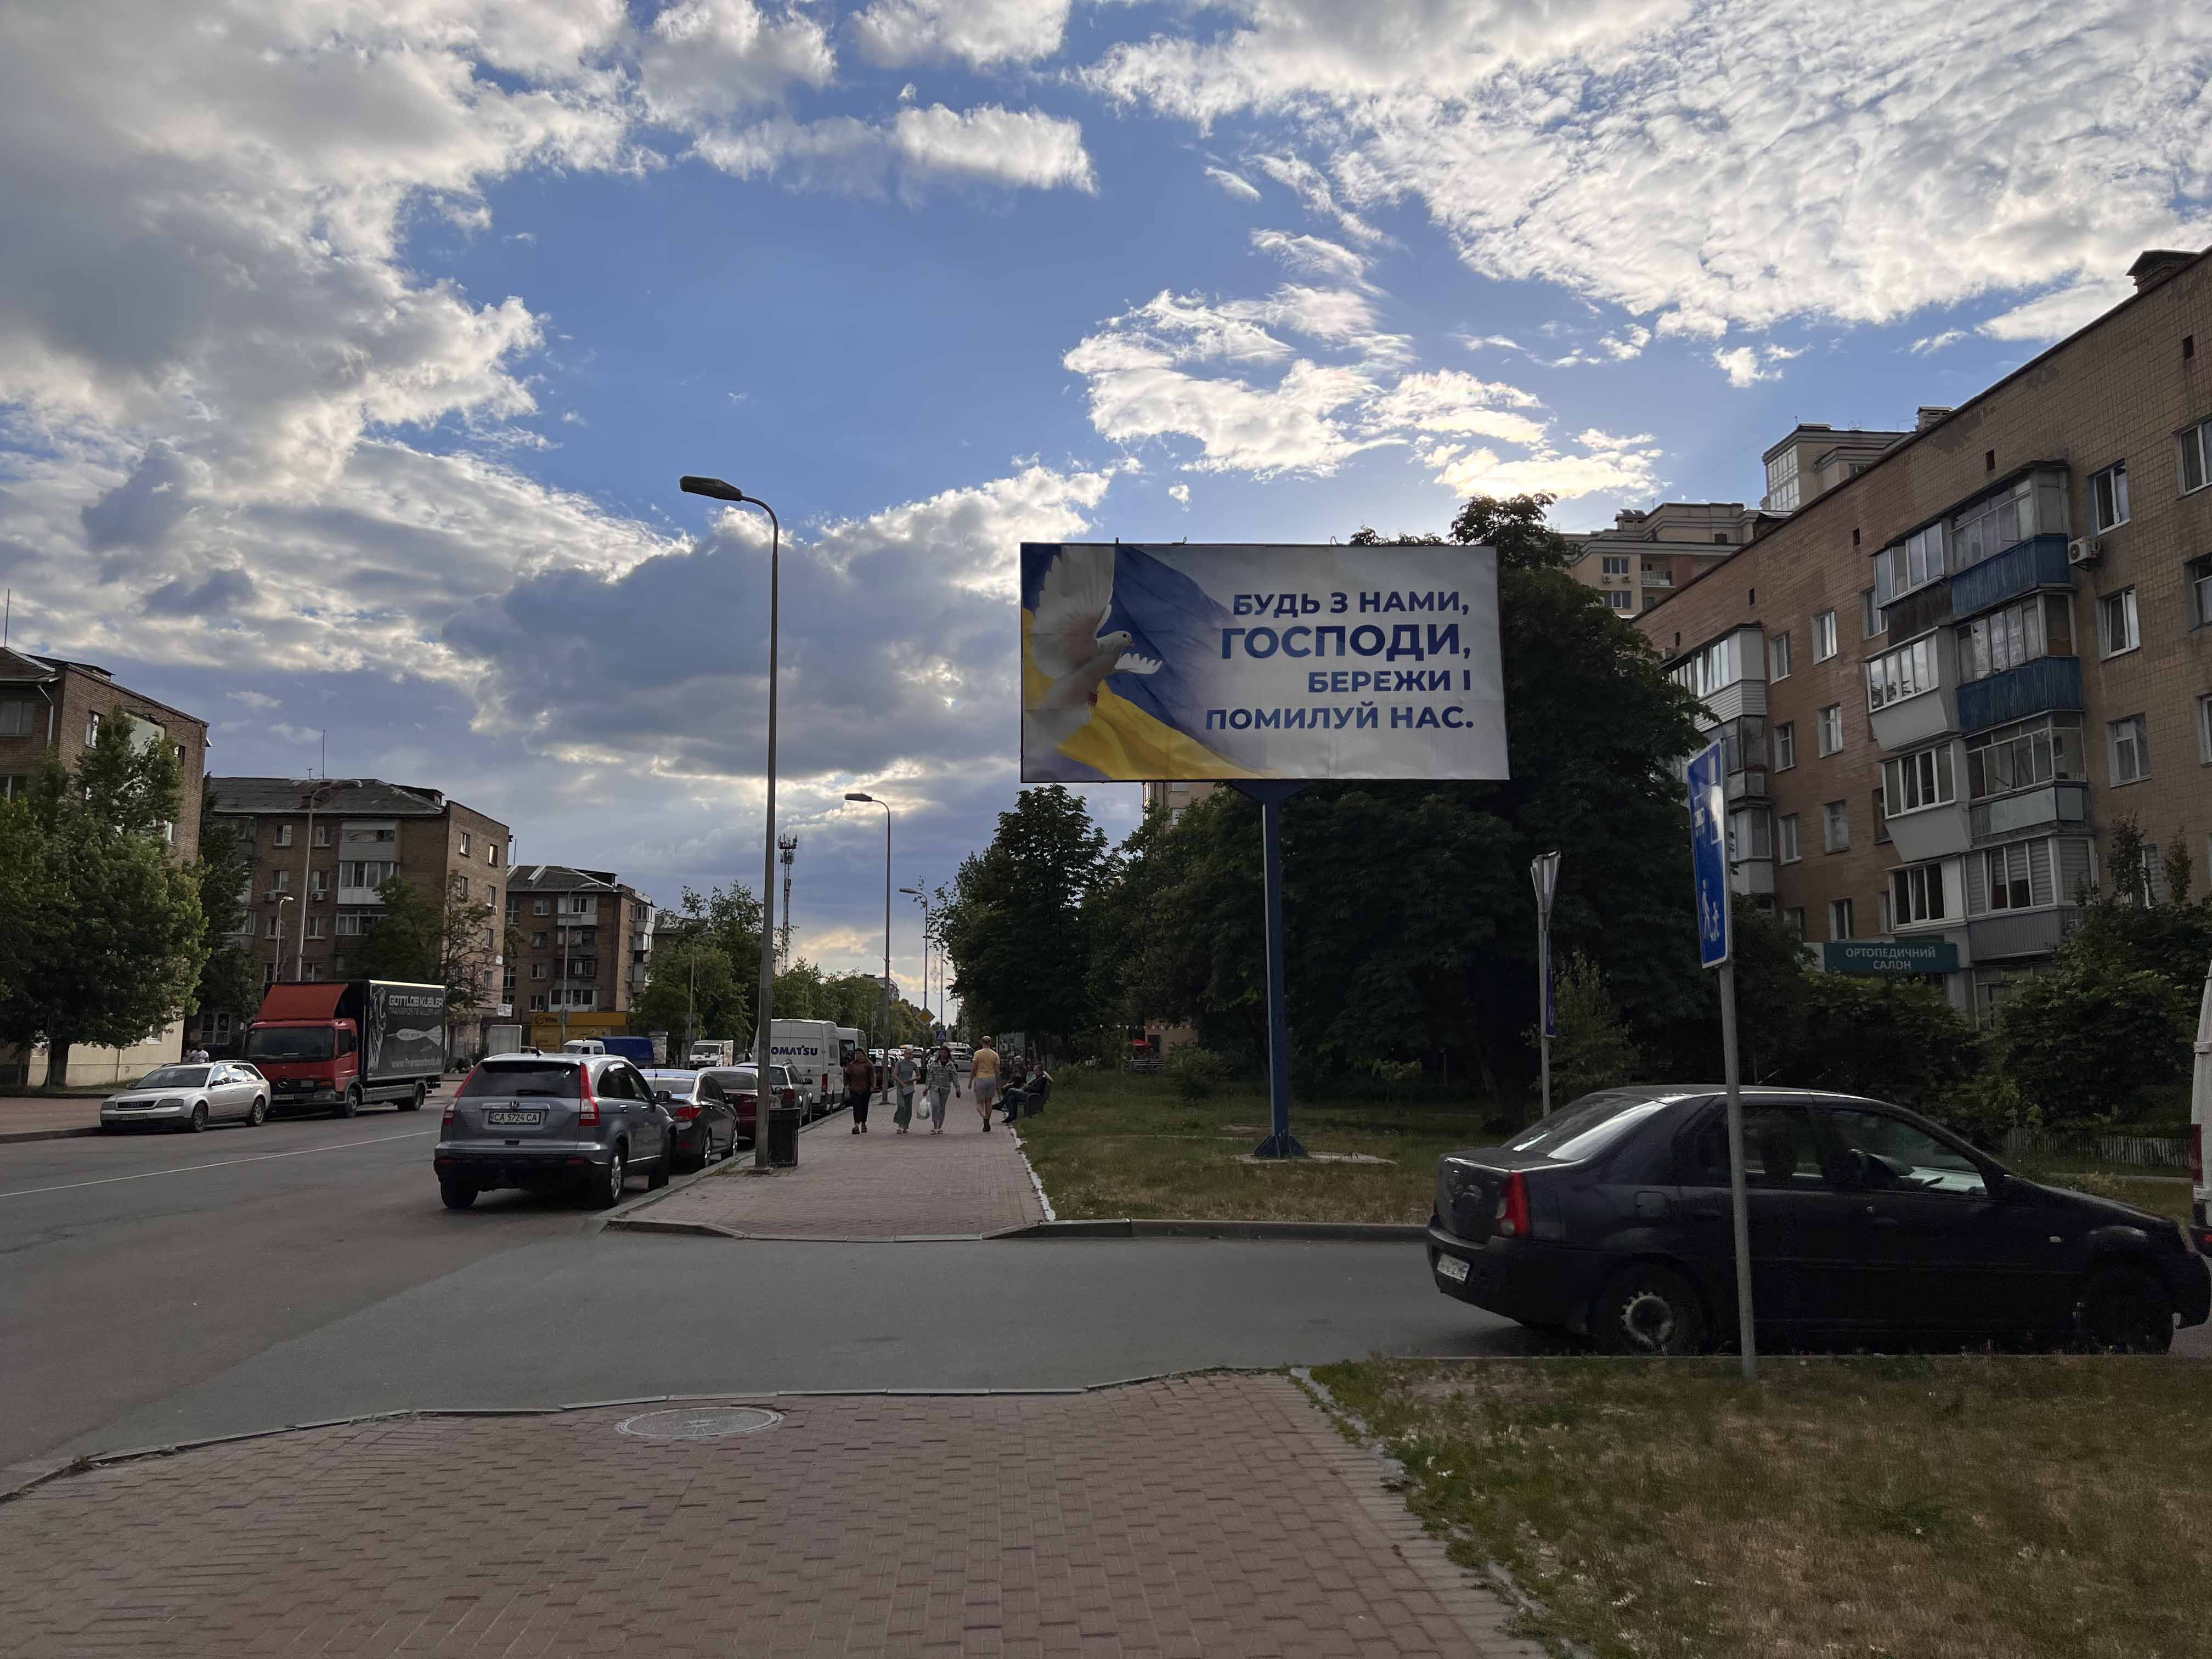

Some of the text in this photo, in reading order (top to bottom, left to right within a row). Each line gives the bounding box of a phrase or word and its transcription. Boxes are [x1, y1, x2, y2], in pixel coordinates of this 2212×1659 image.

[1233, 591, 1469, 619] БУДЬ З НАМИ,
[1221, 623, 1471, 662] ГОСПОДИ,
[1308, 669, 1471, 693] БЕРЕЖИ І
[1204, 701, 1474, 731] ПОМИЛУЙ НАС.
[1845, 946, 1936, 960] ОРТОПЕДИЧНИЙ
[1873, 960, 1911, 970] САЛОН
[389, 995, 419, 1007] GOTTLOB
[771, 1045, 818, 1056] OMATSU
